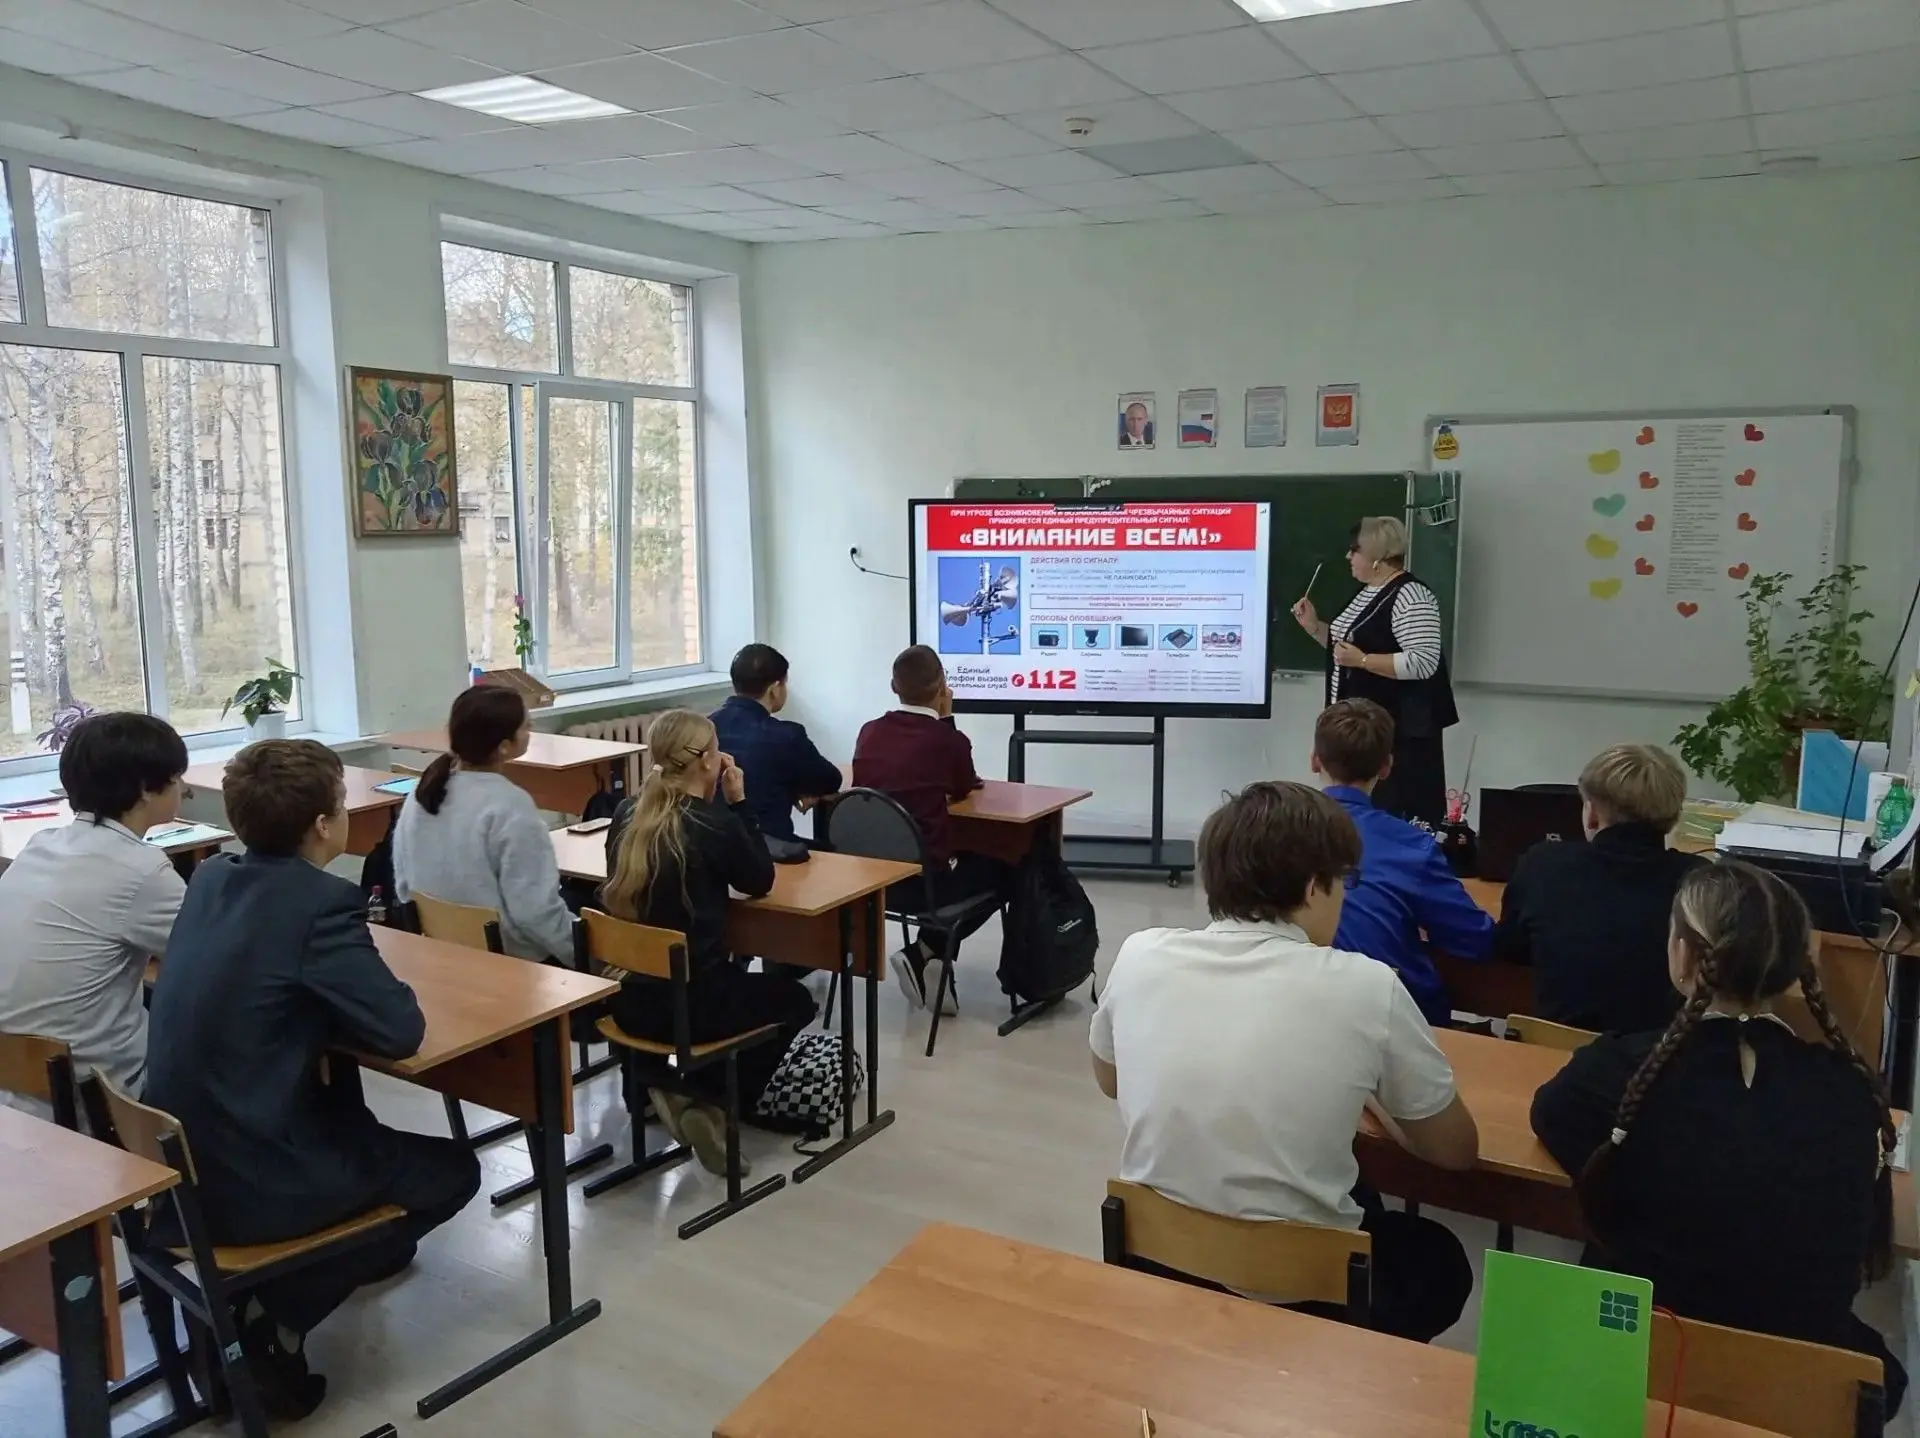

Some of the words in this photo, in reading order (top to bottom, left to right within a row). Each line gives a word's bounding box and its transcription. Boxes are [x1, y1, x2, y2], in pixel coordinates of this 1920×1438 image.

[1042, 517, 1074, 525] ЕДИНЫЙ
[959, 528, 1116, 546] «ВНИМАНИЕ
[1125, 528, 1222, 546] ВСЕМ!»
[1030, 556, 1069, 565] ДЕЙСТВИЯ
[1030, 614, 1068, 622] СПОСОБЫ
[957, 666, 990, 674] Единый
[1028, 670, 1077, 690] 112
